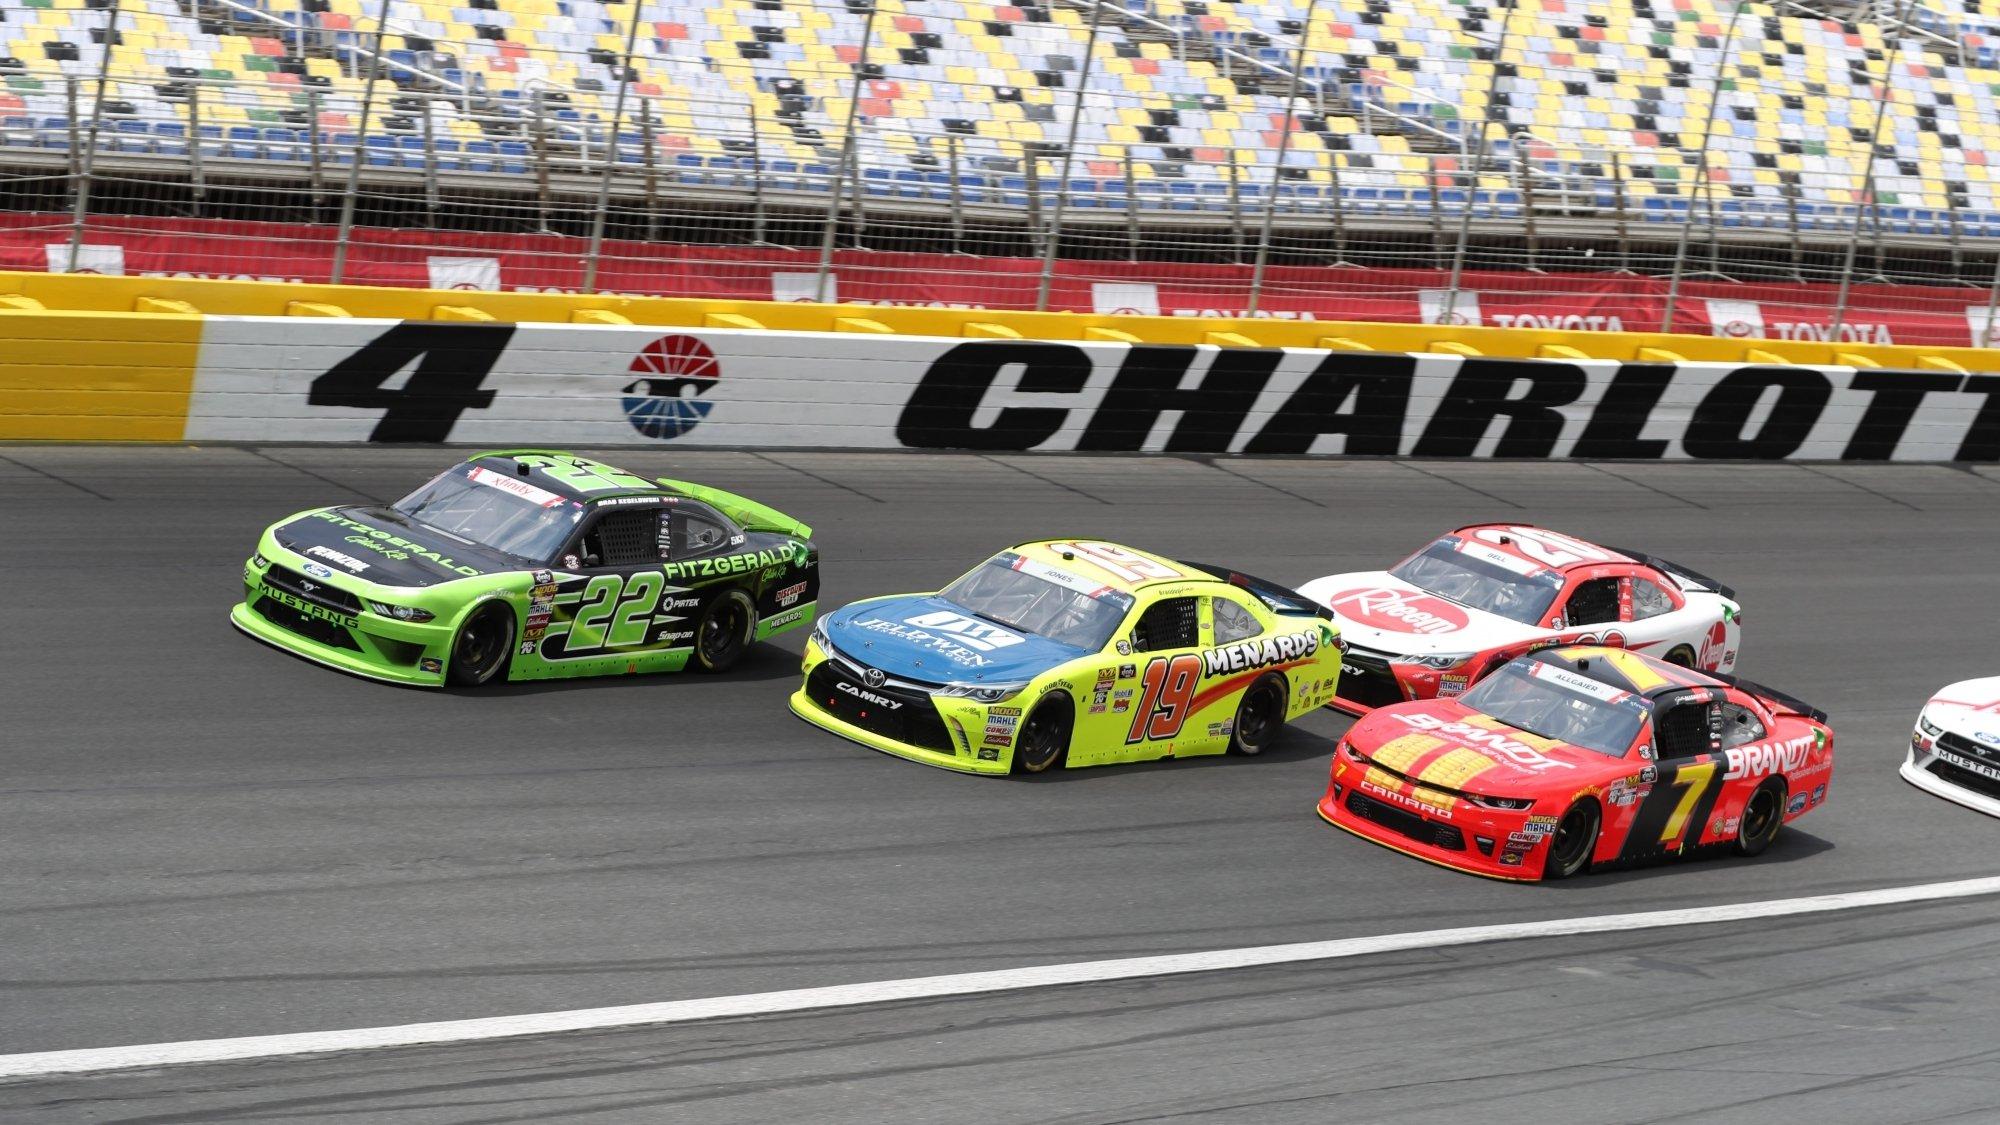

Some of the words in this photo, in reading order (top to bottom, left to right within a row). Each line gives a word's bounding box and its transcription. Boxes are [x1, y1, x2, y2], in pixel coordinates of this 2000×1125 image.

[309, 321, 516, 442] 4
[493, 475, 534, 496] xfinity
[312, 511, 480, 577] FITZGERALD
[663, 545, 794, 579] FITZGERALD
[1044, 570, 1073, 583] JONES
[258, 582, 360, 629] MUSTANG
[563, 571, 666, 651] 22
[673, 599, 700, 608] PIRTEK
[770, 611, 804, 630] MENARDS
[1332, 588, 1460, 634] Rheem
[657, 630, 694, 641] Snap-on
[1203, 629, 1319, 679] MENARDS
[835, 681, 903, 710] CAMRY
[1125, 654, 1203, 745] 19
[1555, 673, 1598, 692] ALLGAIER
[987, 715, 1017, 725] MAHLE
[988, 707, 1021, 716] MOOG
[1390, 713, 1576, 770] BRANDT
[1722, 735, 1814, 780] BRANDT
[1337, 762, 1347, 778] 7
[1360, 781, 1453, 819] CAMARO
[1660, 761, 1718, 840] 7
[1524, 824, 1557, 832] MAHLE
